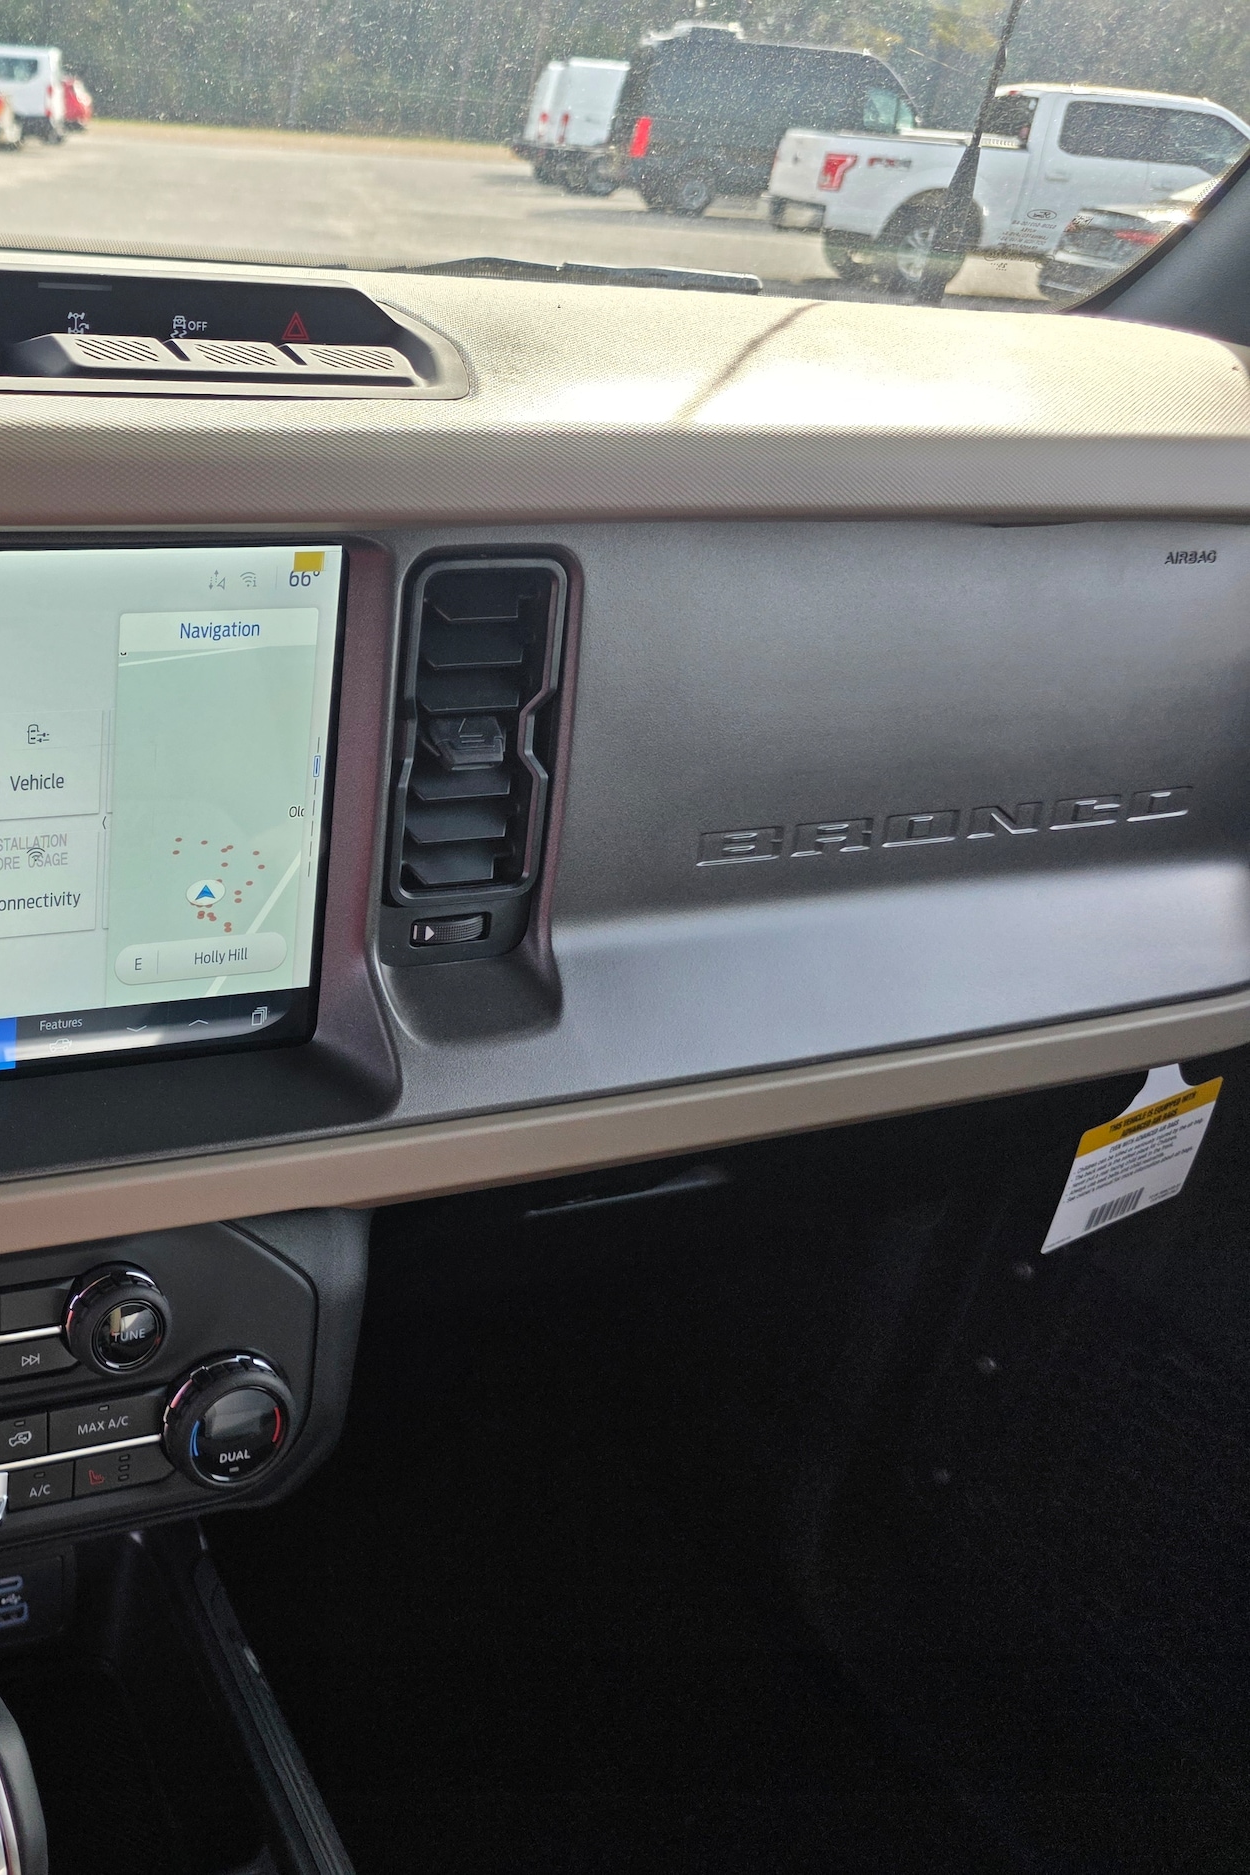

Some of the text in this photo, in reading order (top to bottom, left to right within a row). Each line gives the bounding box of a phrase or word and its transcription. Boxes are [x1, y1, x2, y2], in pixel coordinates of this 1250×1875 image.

[188, 320, 208, 332] OFF
[1164, 550, 1217, 565] AIRBAG
[180, 621, 261, 641] Navigation
[10, 773, 65, 792] Vehicle
[697, 786, 1193, 867] BRONCO
[27, 852, 70, 869] USAGE
[193, 947, 249, 965] Holly Hill
[134, 957, 143, 971] E
[39, 1016, 83, 1031] Features
[114, 1328, 146, 1342] TUNE
[78, 1416, 129, 1435] MAX A/C
[219, 1449, 251, 1464] DUAL
[29, 1485, 51, 1498] A/C
